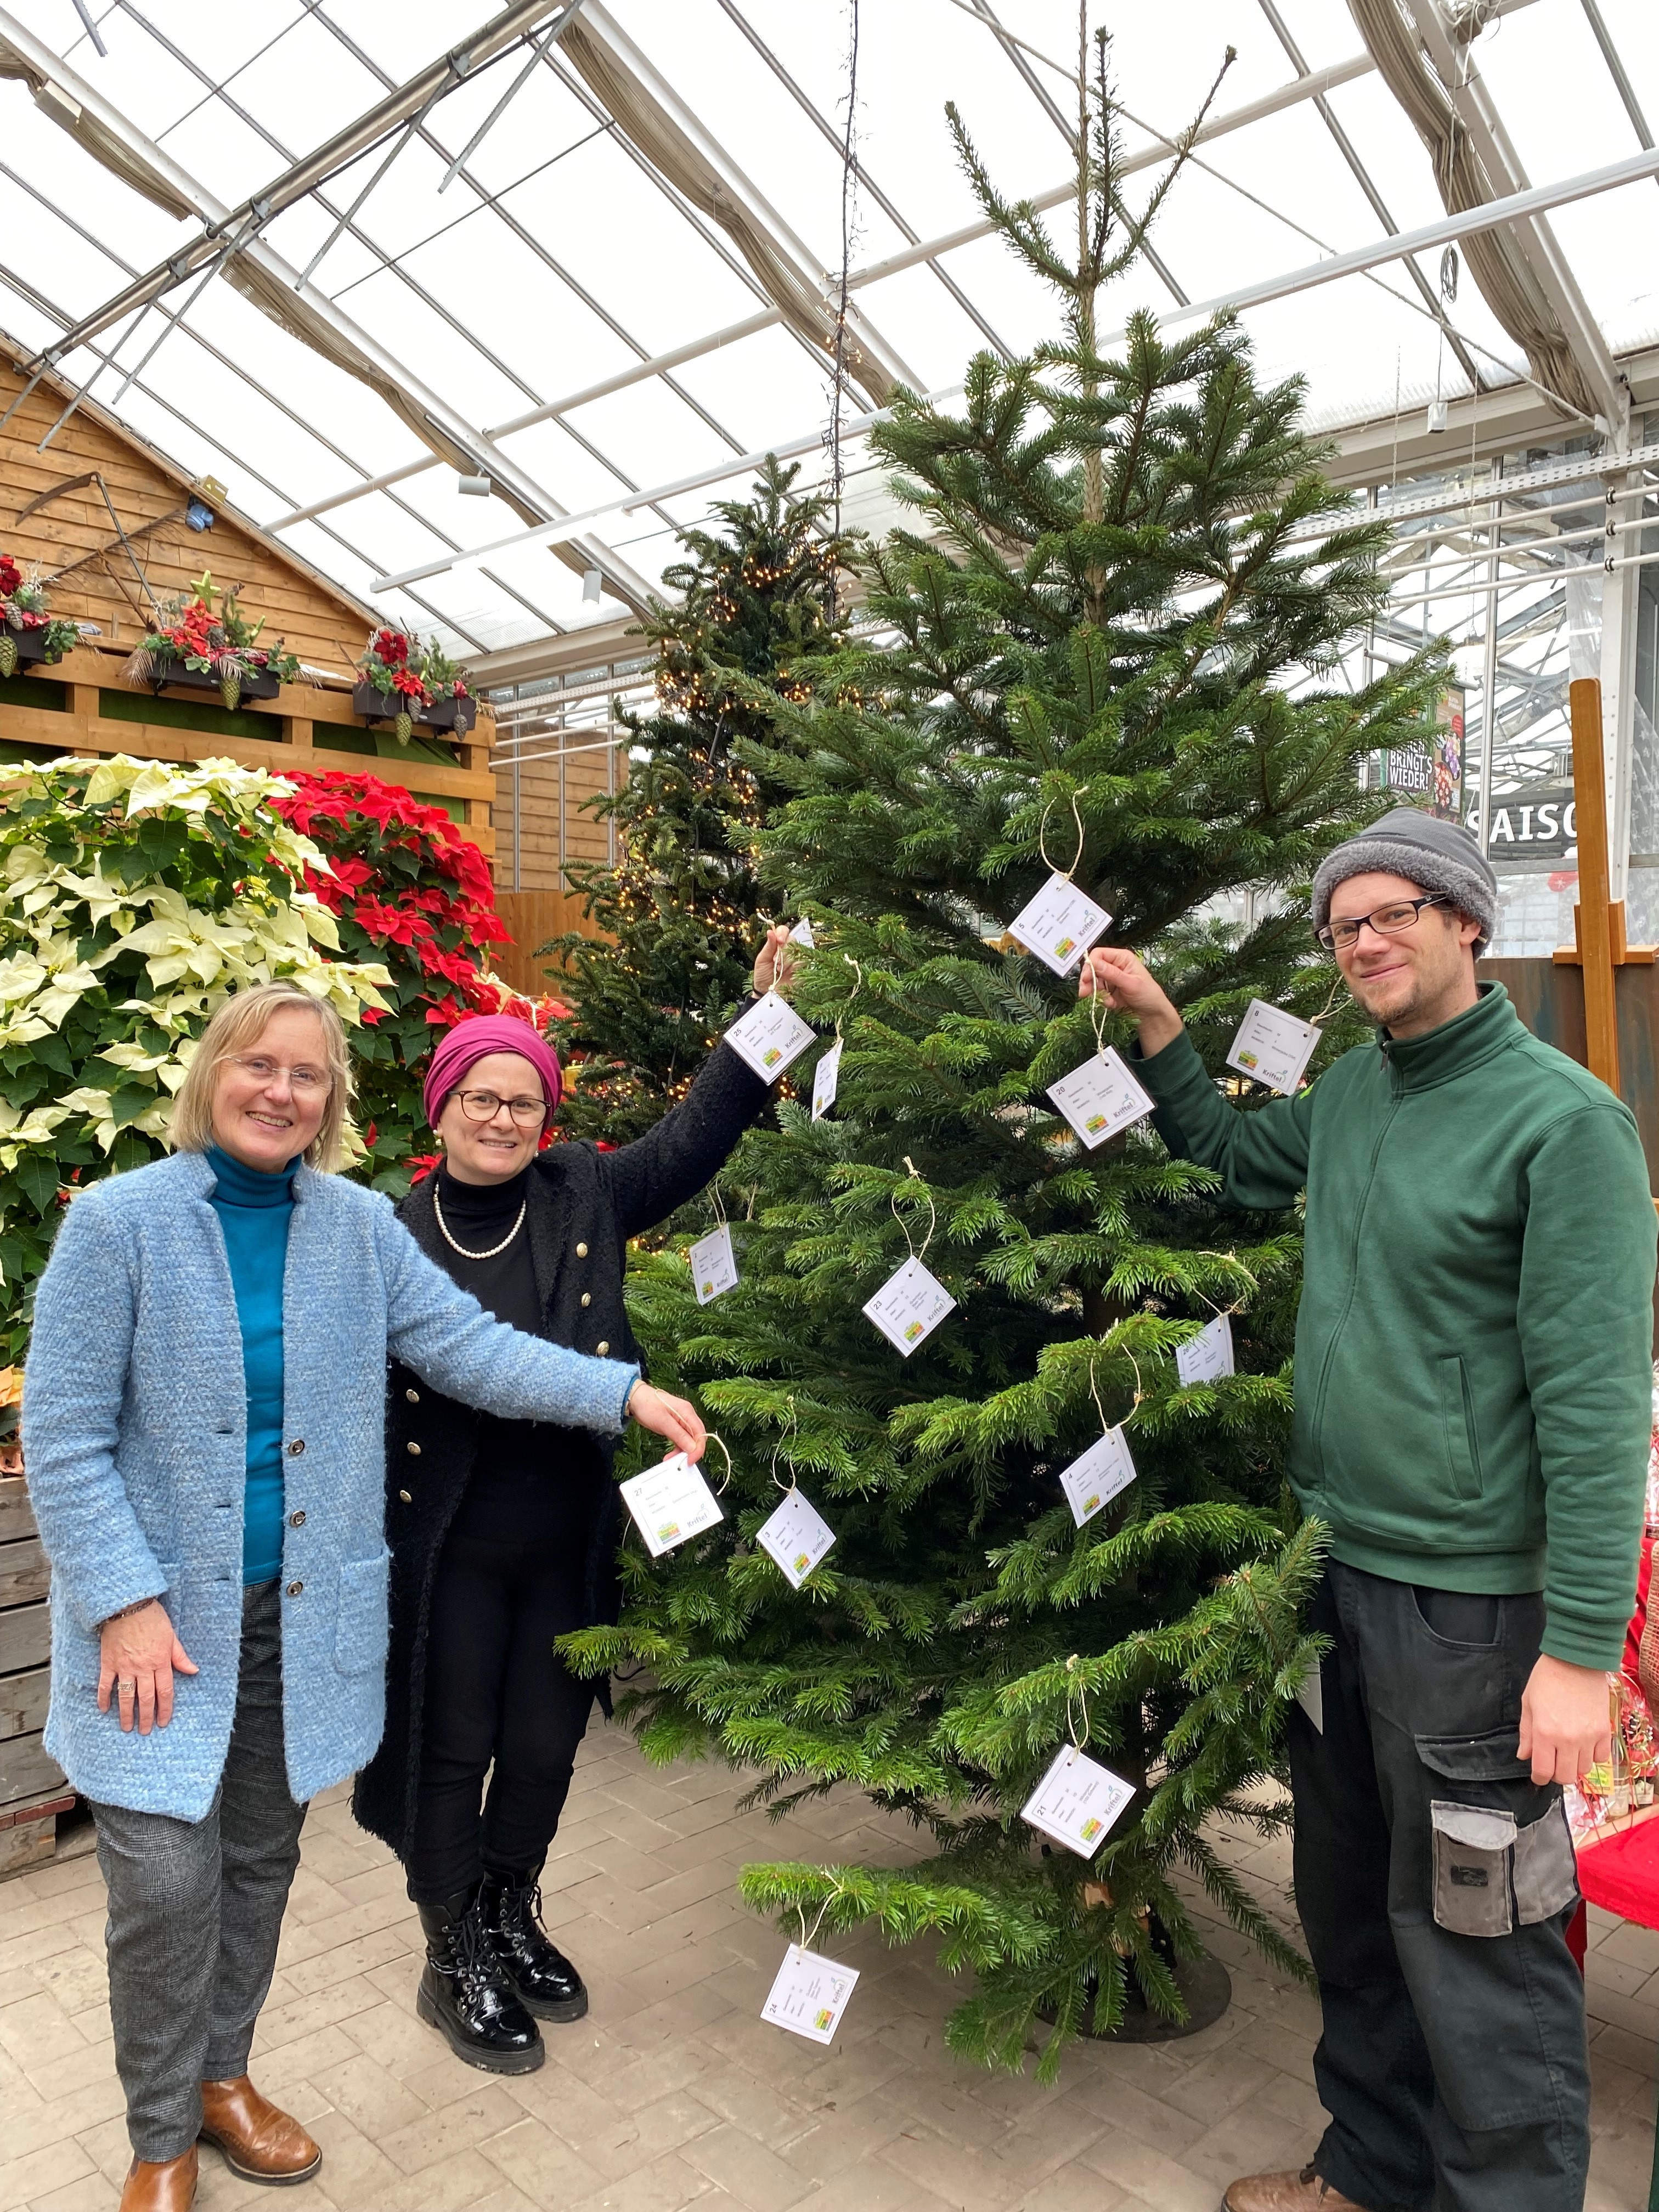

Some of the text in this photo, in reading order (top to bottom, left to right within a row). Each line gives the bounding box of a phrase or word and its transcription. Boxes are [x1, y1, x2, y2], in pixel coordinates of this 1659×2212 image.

[1390, 766, 1429, 791] WIEDER!
[1078, 917, 1096, 937] Kriftel
[733, 1028, 743, 1037] 25
[785, 1031, 802, 1049] Kriftel
[1263, 1069, 1283, 1083] Kriftel
[1056, 1086, 1065, 1095] 20
[1113, 1102, 1134, 1119] Kriftel
[716, 1277, 728, 1288] Kriftel
[873, 1300, 882, 1310] 23
[927, 1304, 945, 1322] Kriftel
[634, 1487, 643, 1497] 27
[1106, 1479, 1122, 1496] Kriftel
[687, 1513, 708, 1528] Kriftel
[812, 1537, 826, 1555] Kriftel
[1037, 1805, 1047, 1816] 21
[1104, 1793, 1121, 1816] Kriftel
[832, 1983, 845, 2004] Kriftel
[769, 2004, 777, 2014] 24
